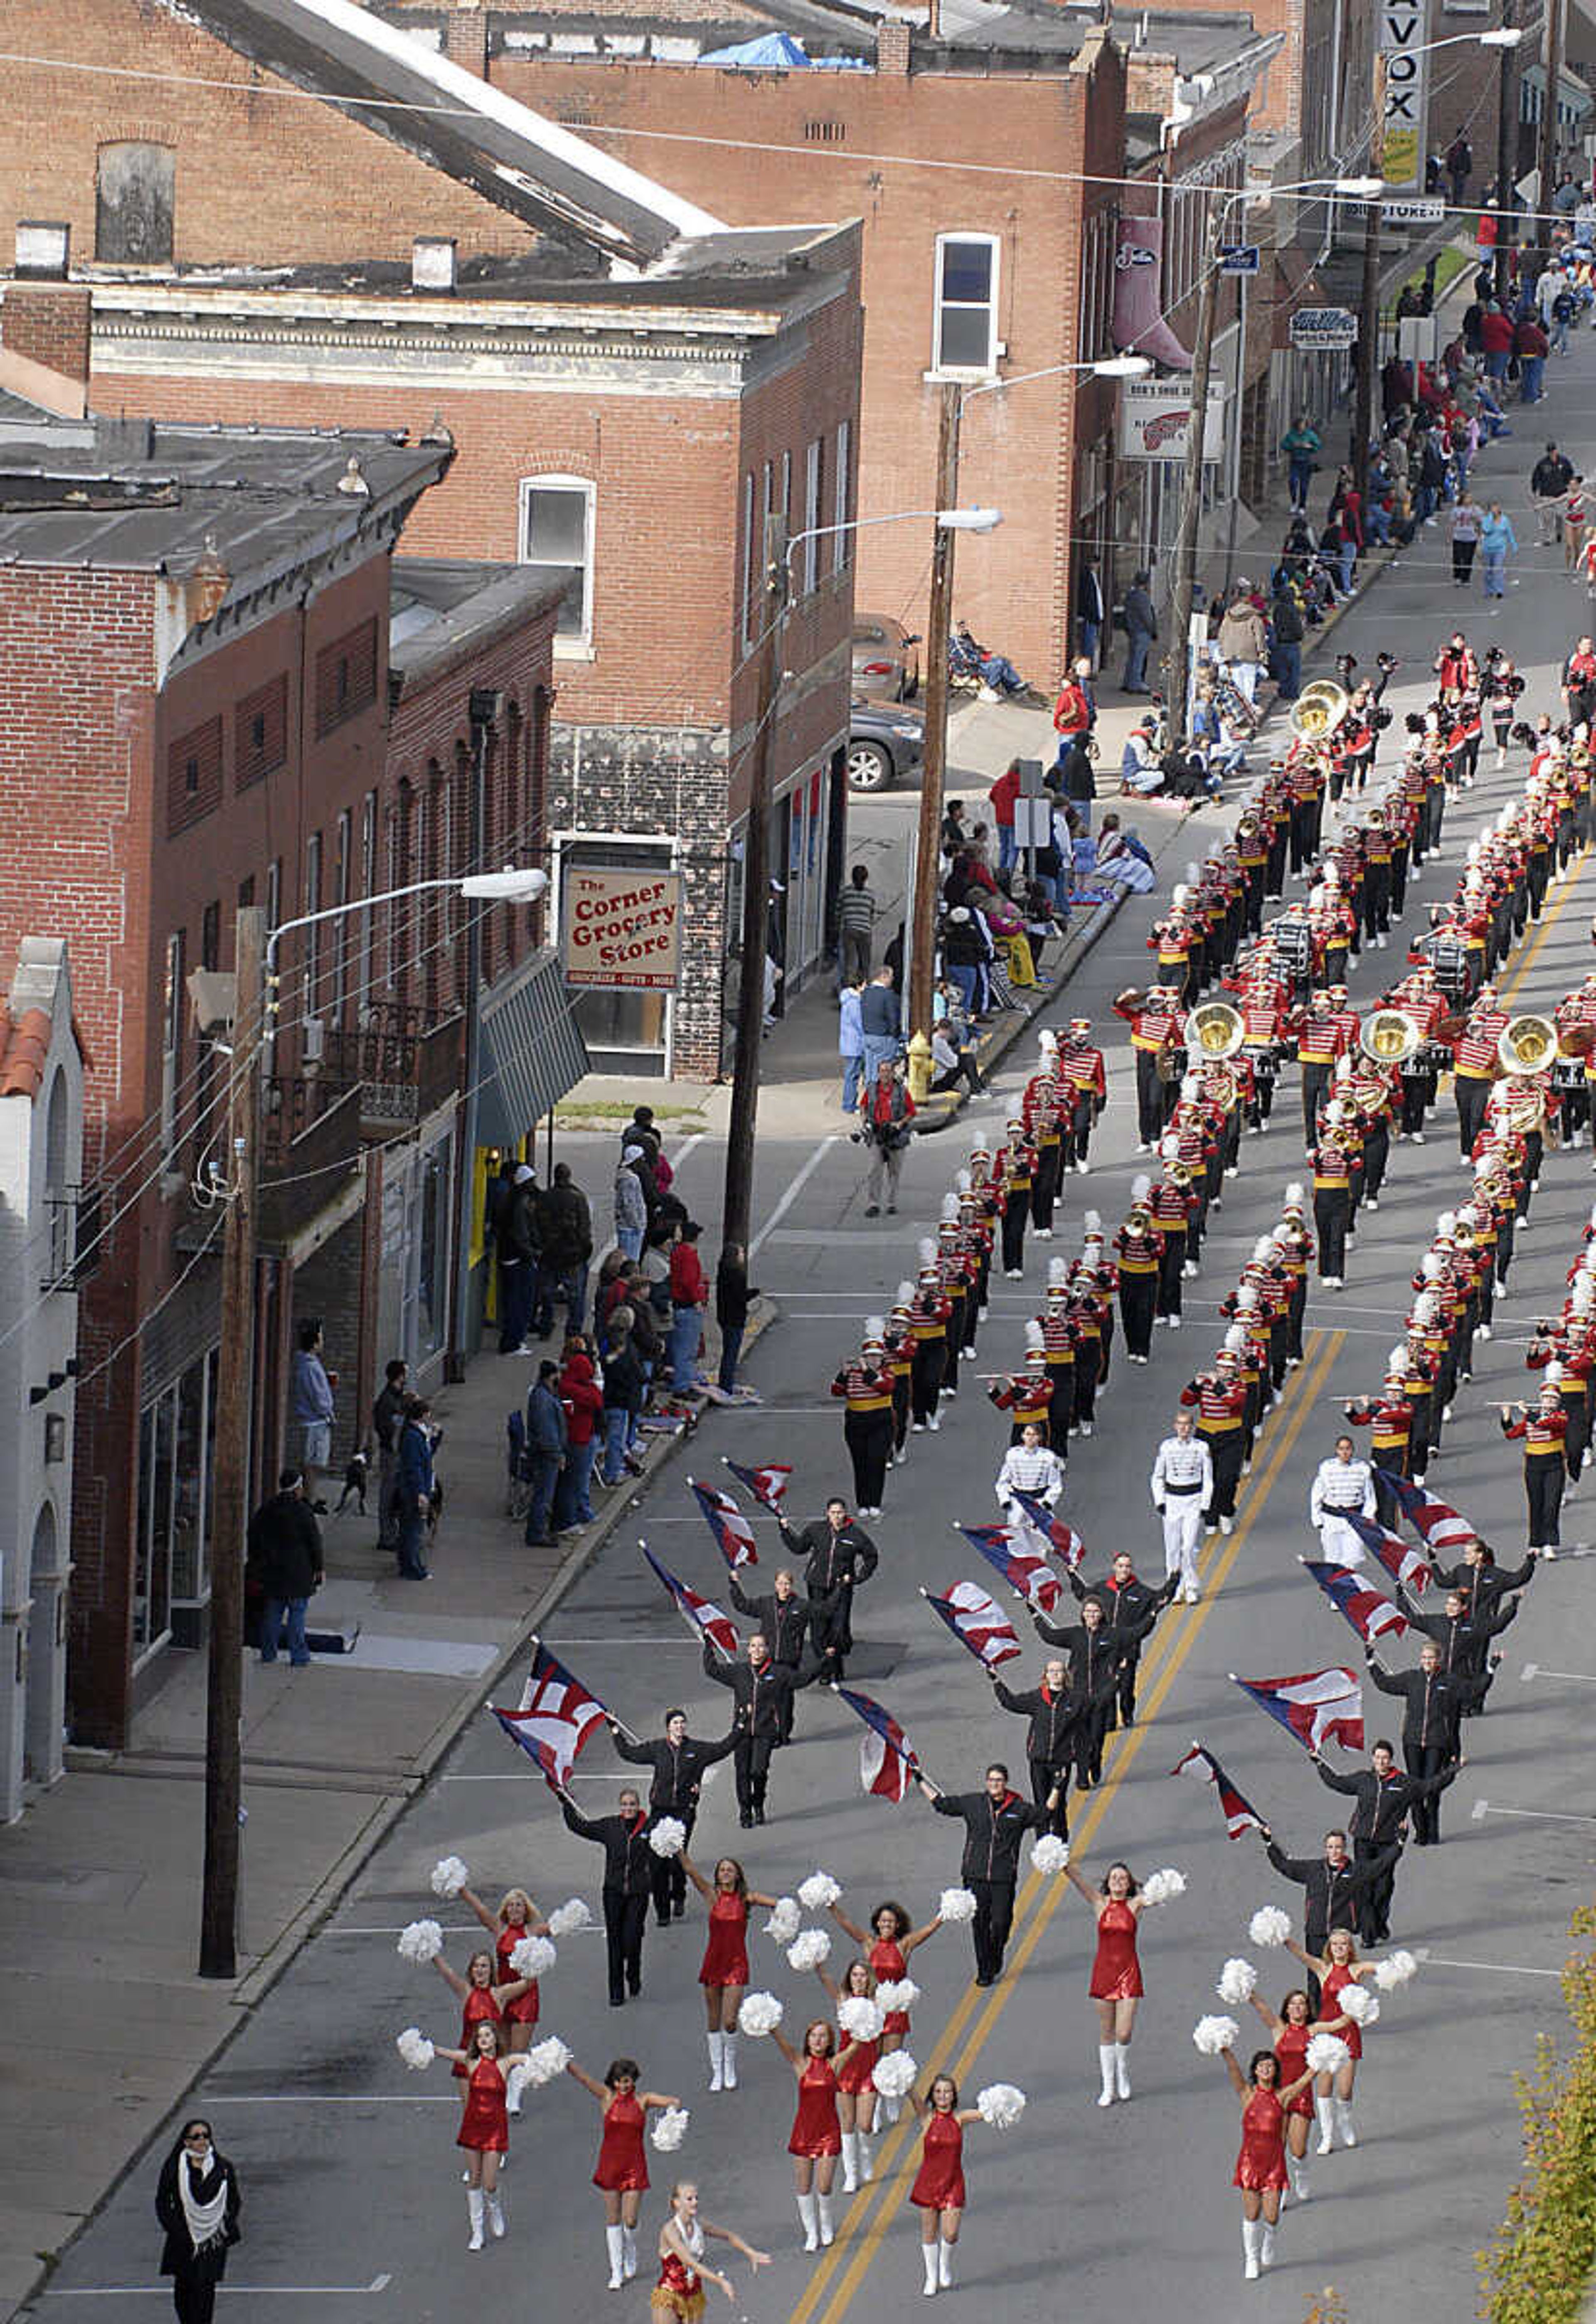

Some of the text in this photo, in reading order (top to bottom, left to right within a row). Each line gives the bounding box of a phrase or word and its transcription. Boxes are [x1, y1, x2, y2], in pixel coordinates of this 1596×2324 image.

[1384, 0, 1417, 118] VOX
[575, 883, 666, 921] Corner
[579, 879, 605, 891] The
[573, 904, 676, 947] Grocery
[599, 934, 670, 967] Store
